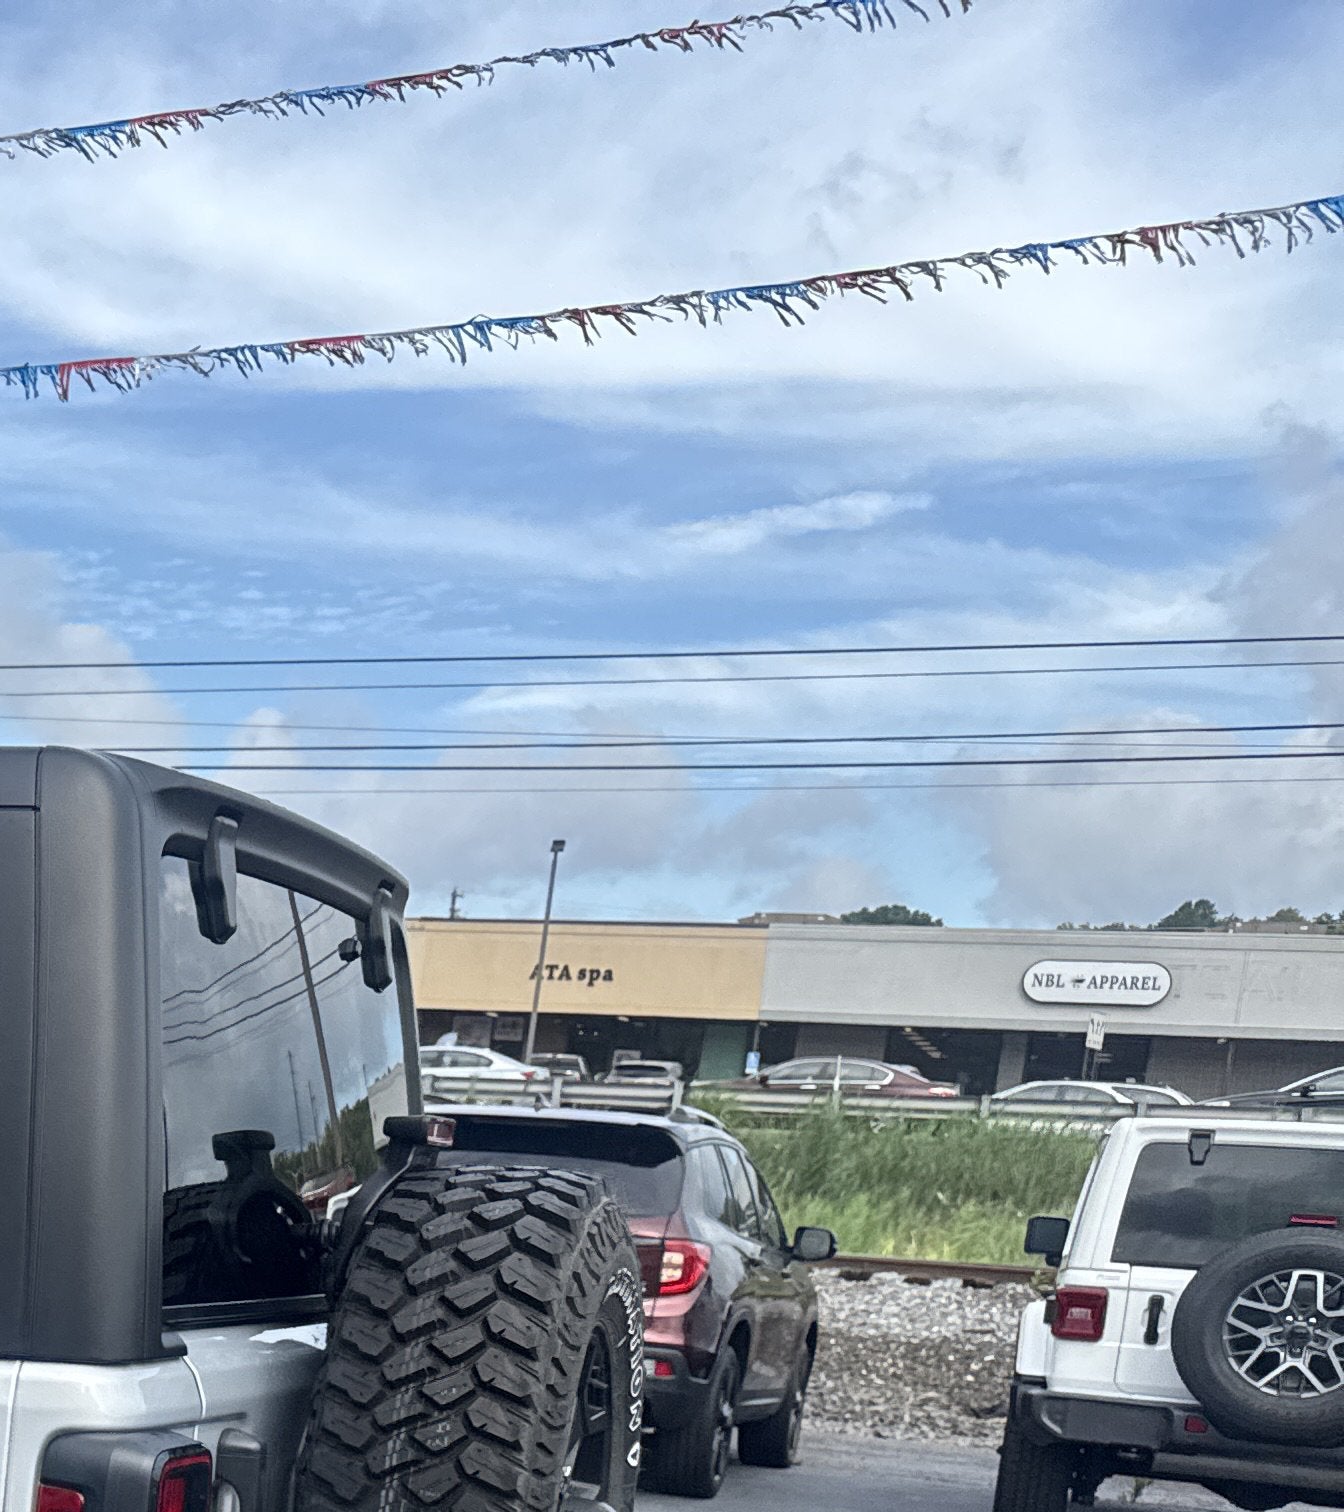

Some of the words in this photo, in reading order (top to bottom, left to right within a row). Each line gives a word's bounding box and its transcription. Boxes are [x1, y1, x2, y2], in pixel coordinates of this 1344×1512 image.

[529, 964, 572, 981] ATA
[577, 968, 614, 987] spa
[1032, 973, 1065, 989] NBL
[1087, 974, 1161, 992] APPAREL
